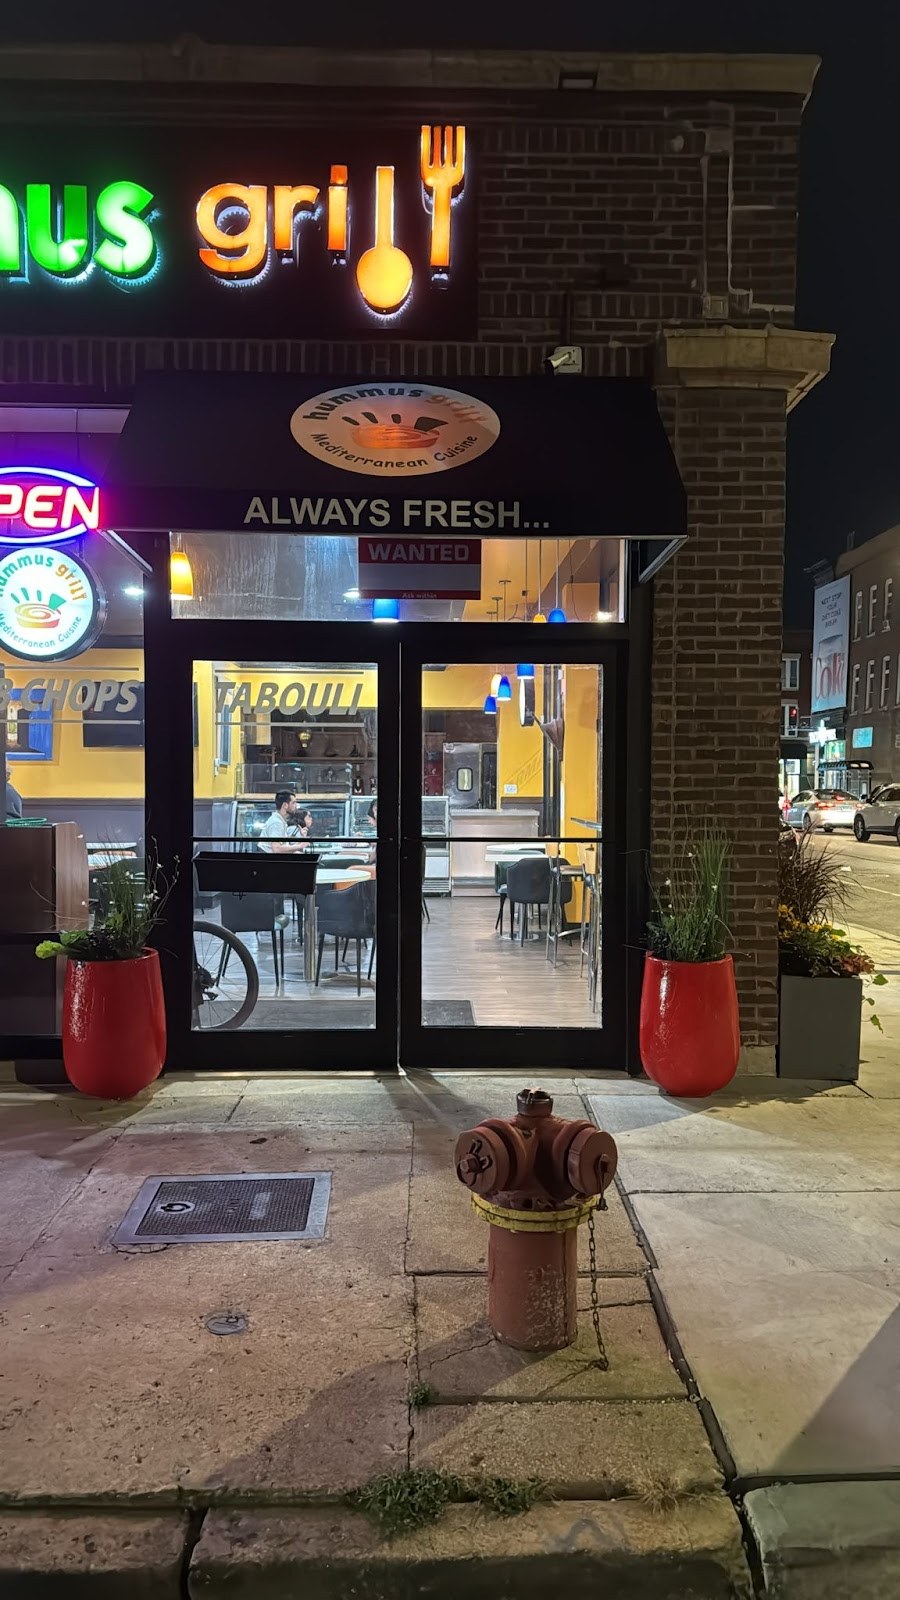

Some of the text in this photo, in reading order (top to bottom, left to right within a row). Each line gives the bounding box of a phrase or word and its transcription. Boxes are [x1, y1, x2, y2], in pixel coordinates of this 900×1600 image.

[302, 387, 424, 421] hummus
[311, 433, 478, 468] Mediterranean Cuisine
[243, 496, 550, 529] ALWAYS FRESH...
[367, 543, 470, 562] WANTED
[58, 616, 82, 642] Cuisine
[20, 678, 142, 713] CHOPS
[215, 682, 364, 716] TABOULI
